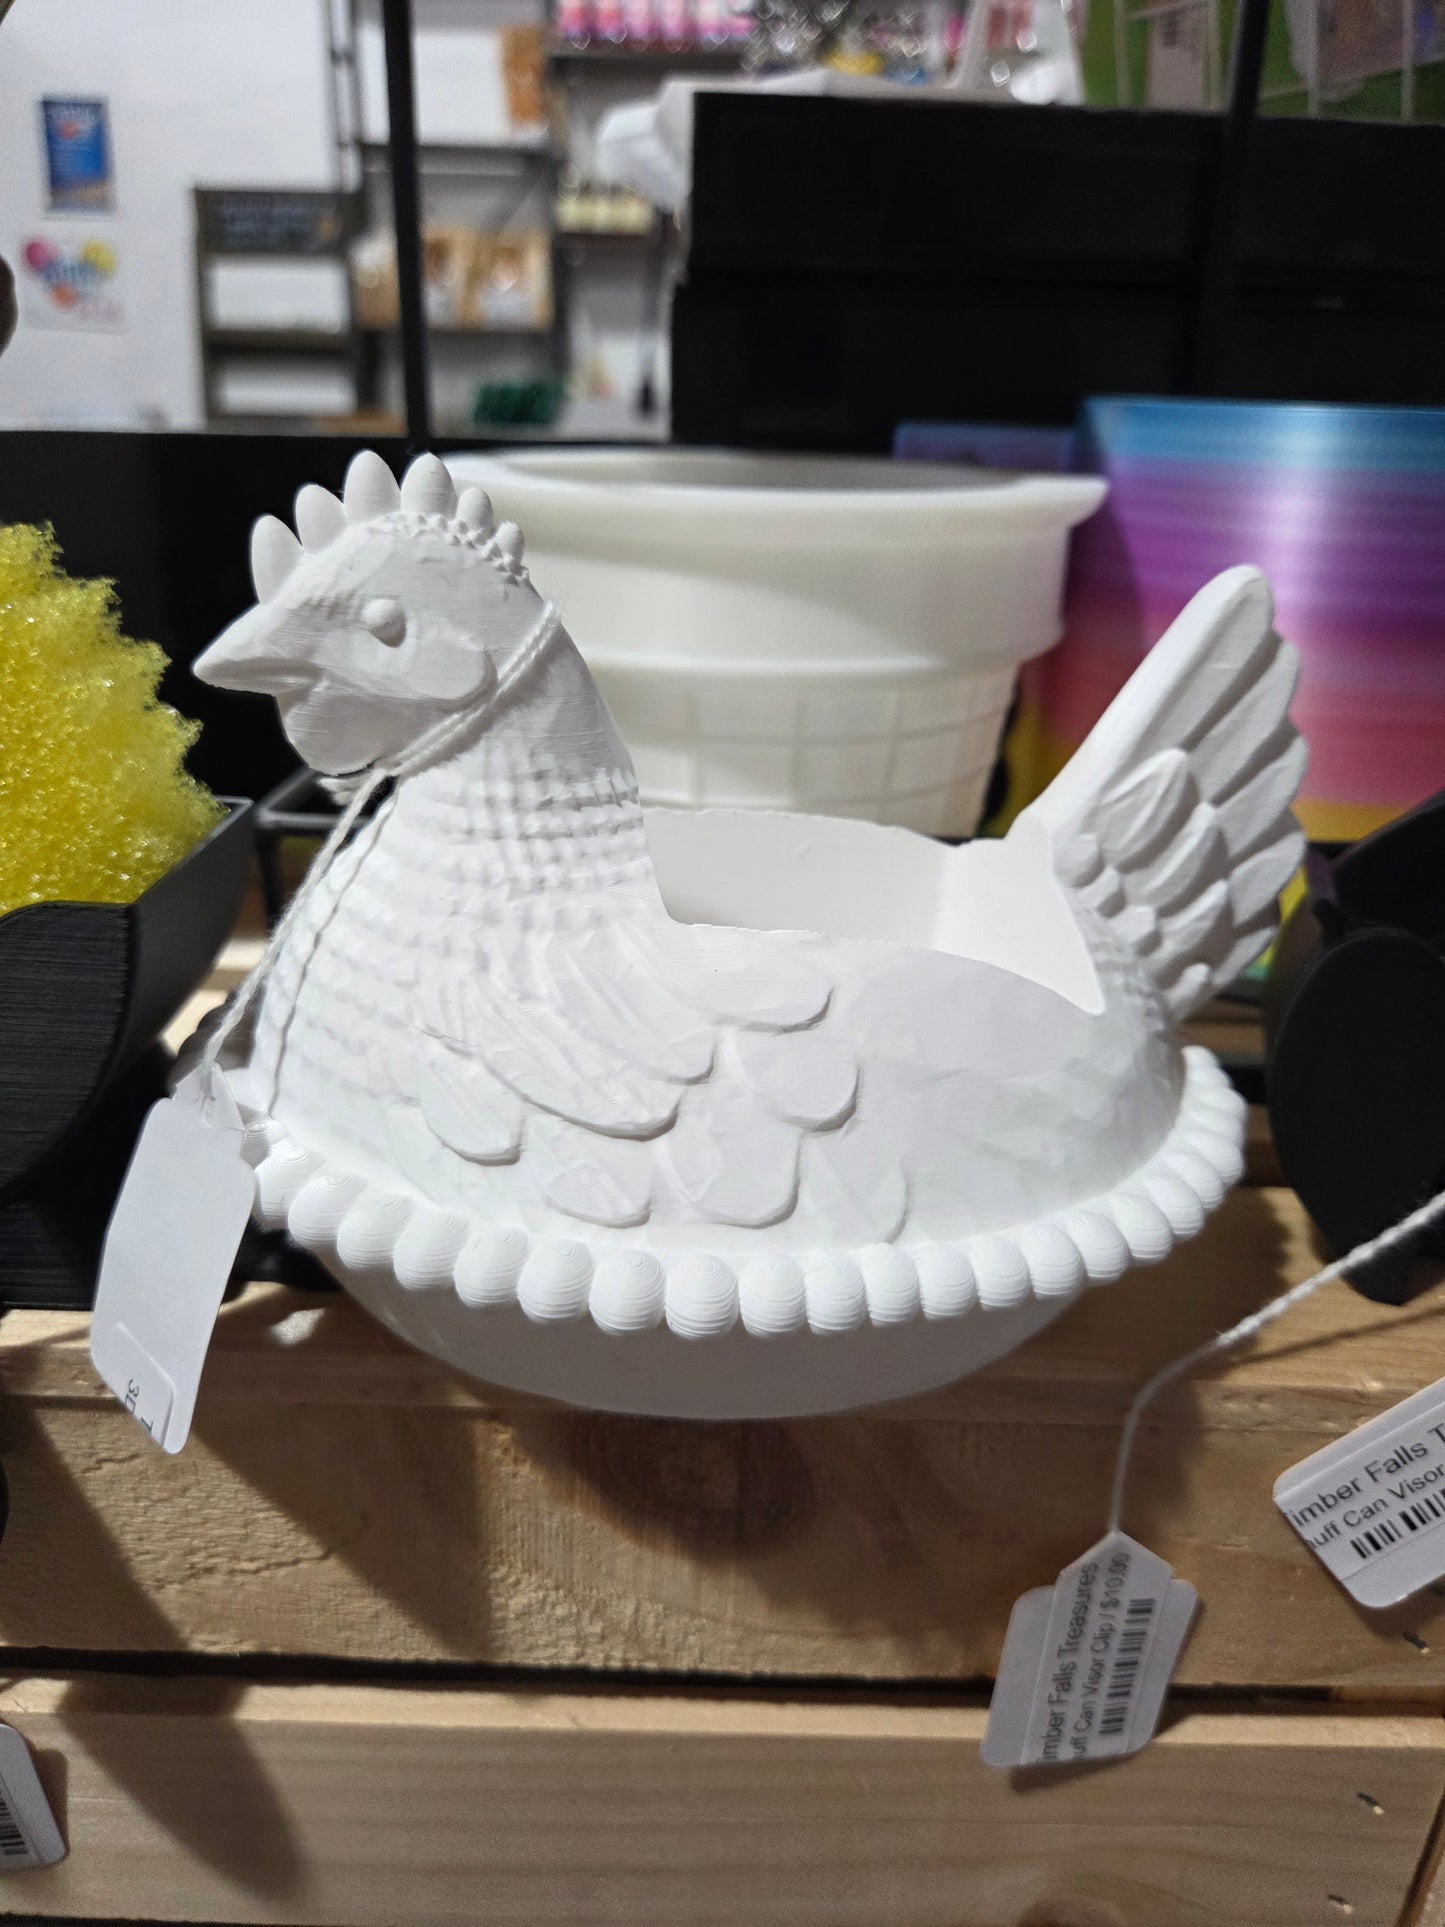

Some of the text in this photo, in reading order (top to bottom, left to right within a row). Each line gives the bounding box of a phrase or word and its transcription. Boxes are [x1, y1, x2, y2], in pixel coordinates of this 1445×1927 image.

[1286, 1477, 1362, 1526] imber
[1364, 1442, 1428, 1484] Falls
[1342, 1497, 1389, 1527] Can
[1386, 1464, 1444, 1500] Visor
[1037, 1562, 1098, 1761] imber Falls Treasures
[1090, 1622, 1115, 1653] Clip
[1080, 1658, 1105, 1697] Visor
[1073, 1700, 1096, 1731] Can
